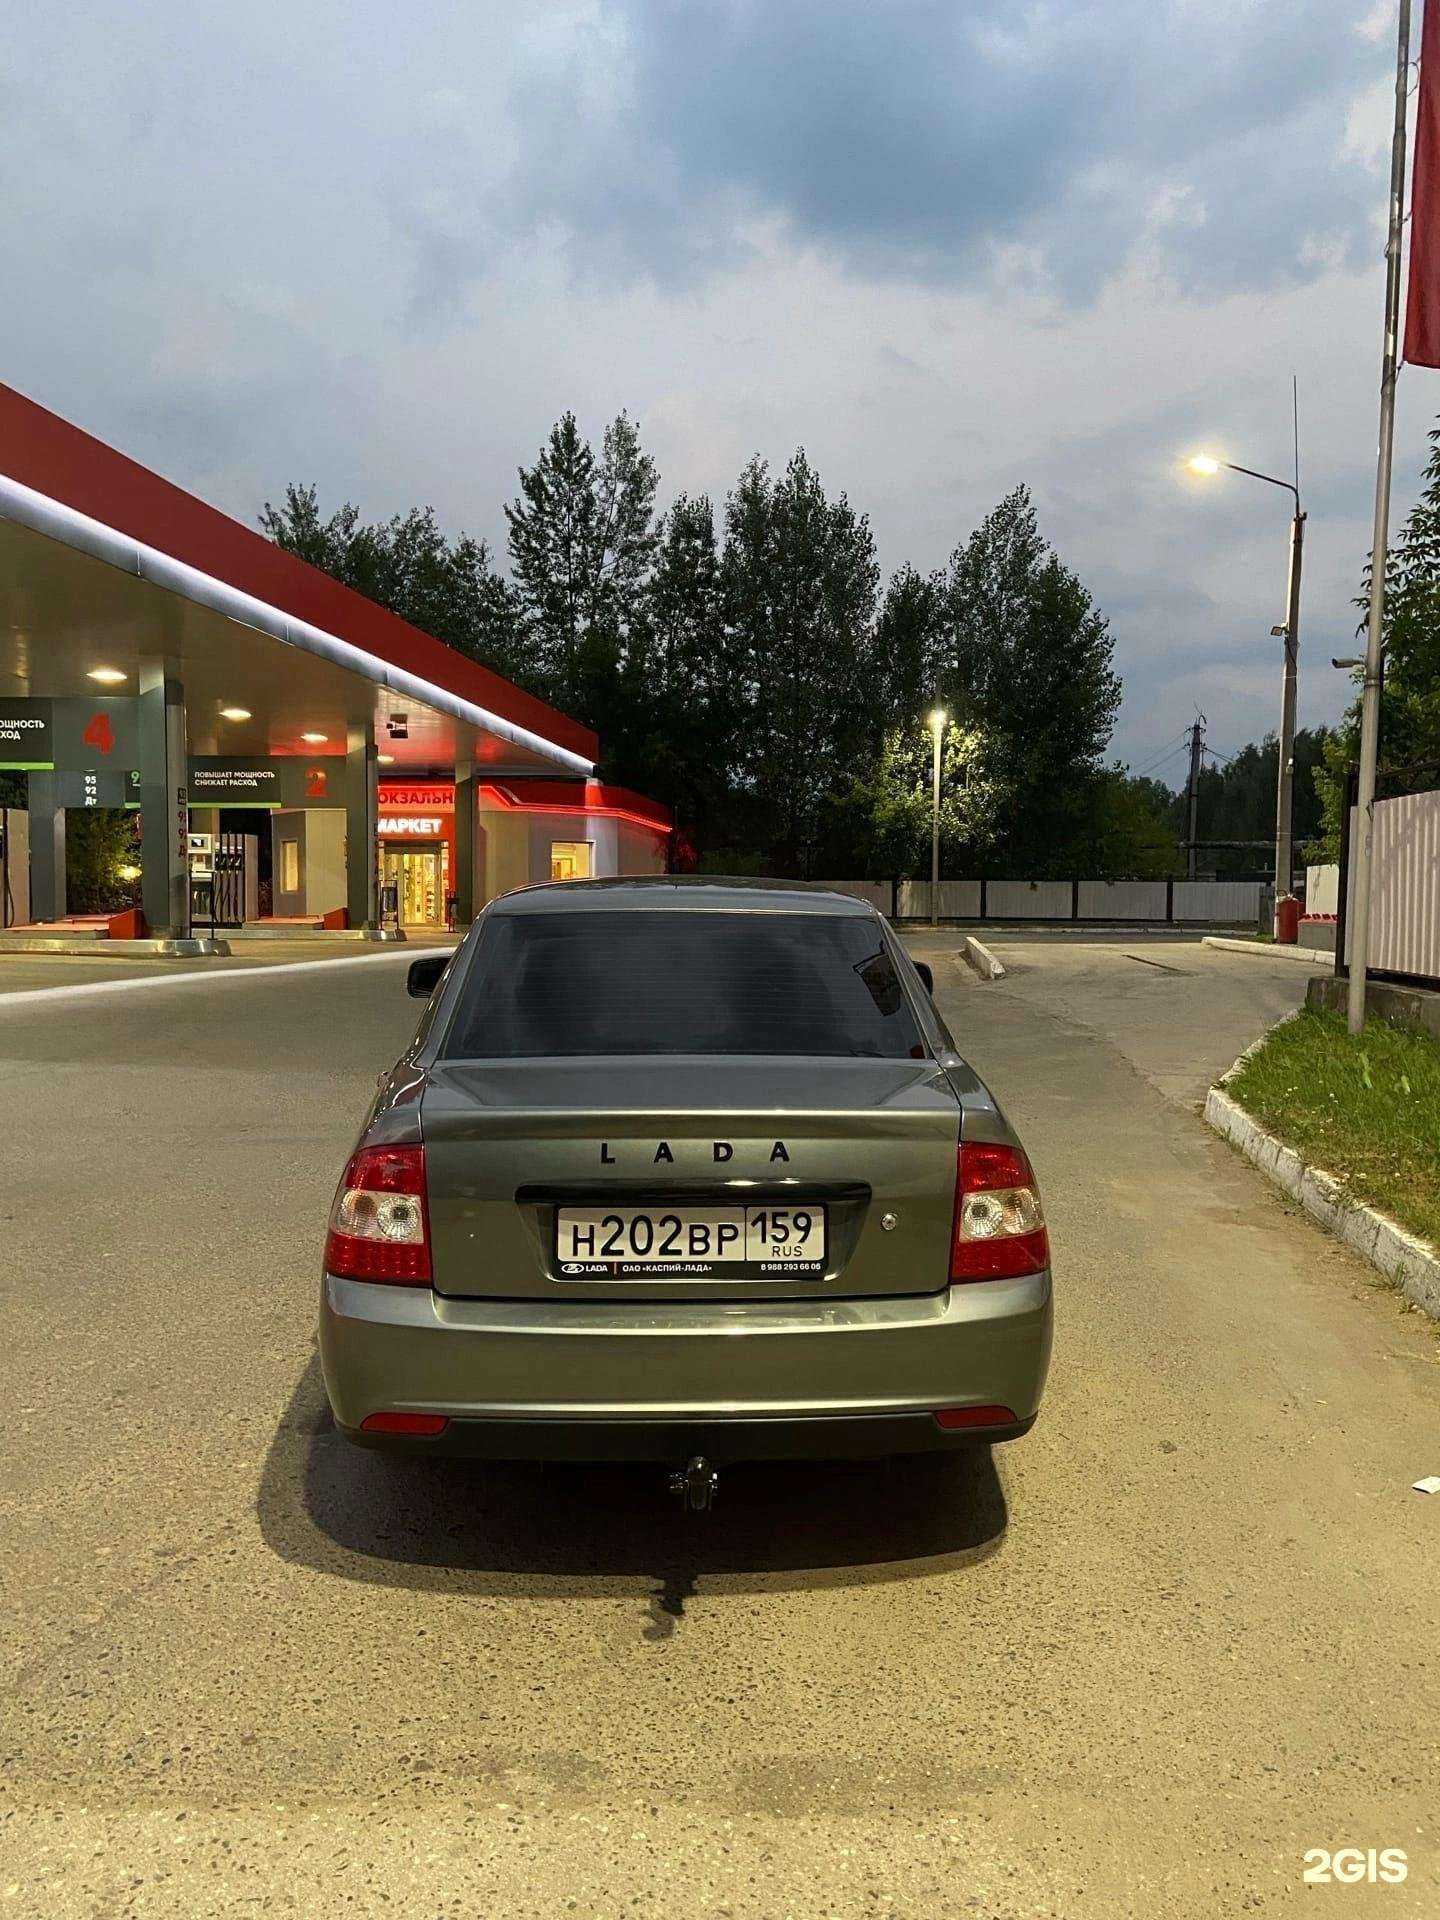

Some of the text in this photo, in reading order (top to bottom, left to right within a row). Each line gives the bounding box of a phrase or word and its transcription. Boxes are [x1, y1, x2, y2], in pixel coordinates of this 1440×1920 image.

[83, 712, 115, 755] 4
[84, 775, 97, 785] 95
[131, 771, 141, 783] 9
[194, 770, 275, 780] ПОВЫШАЕТ МОЩНОСТЬ
[194, 778, 259, 788] СНИЖАЕТ РАСХОД
[304, 767, 329, 798] 2
[84, 786, 97, 795] 92
[600, 1141, 791, 1164] LADA
[572, 1211, 812, 1257] Н202ВР 159
[772, 1245, 803, 1257] RUS
